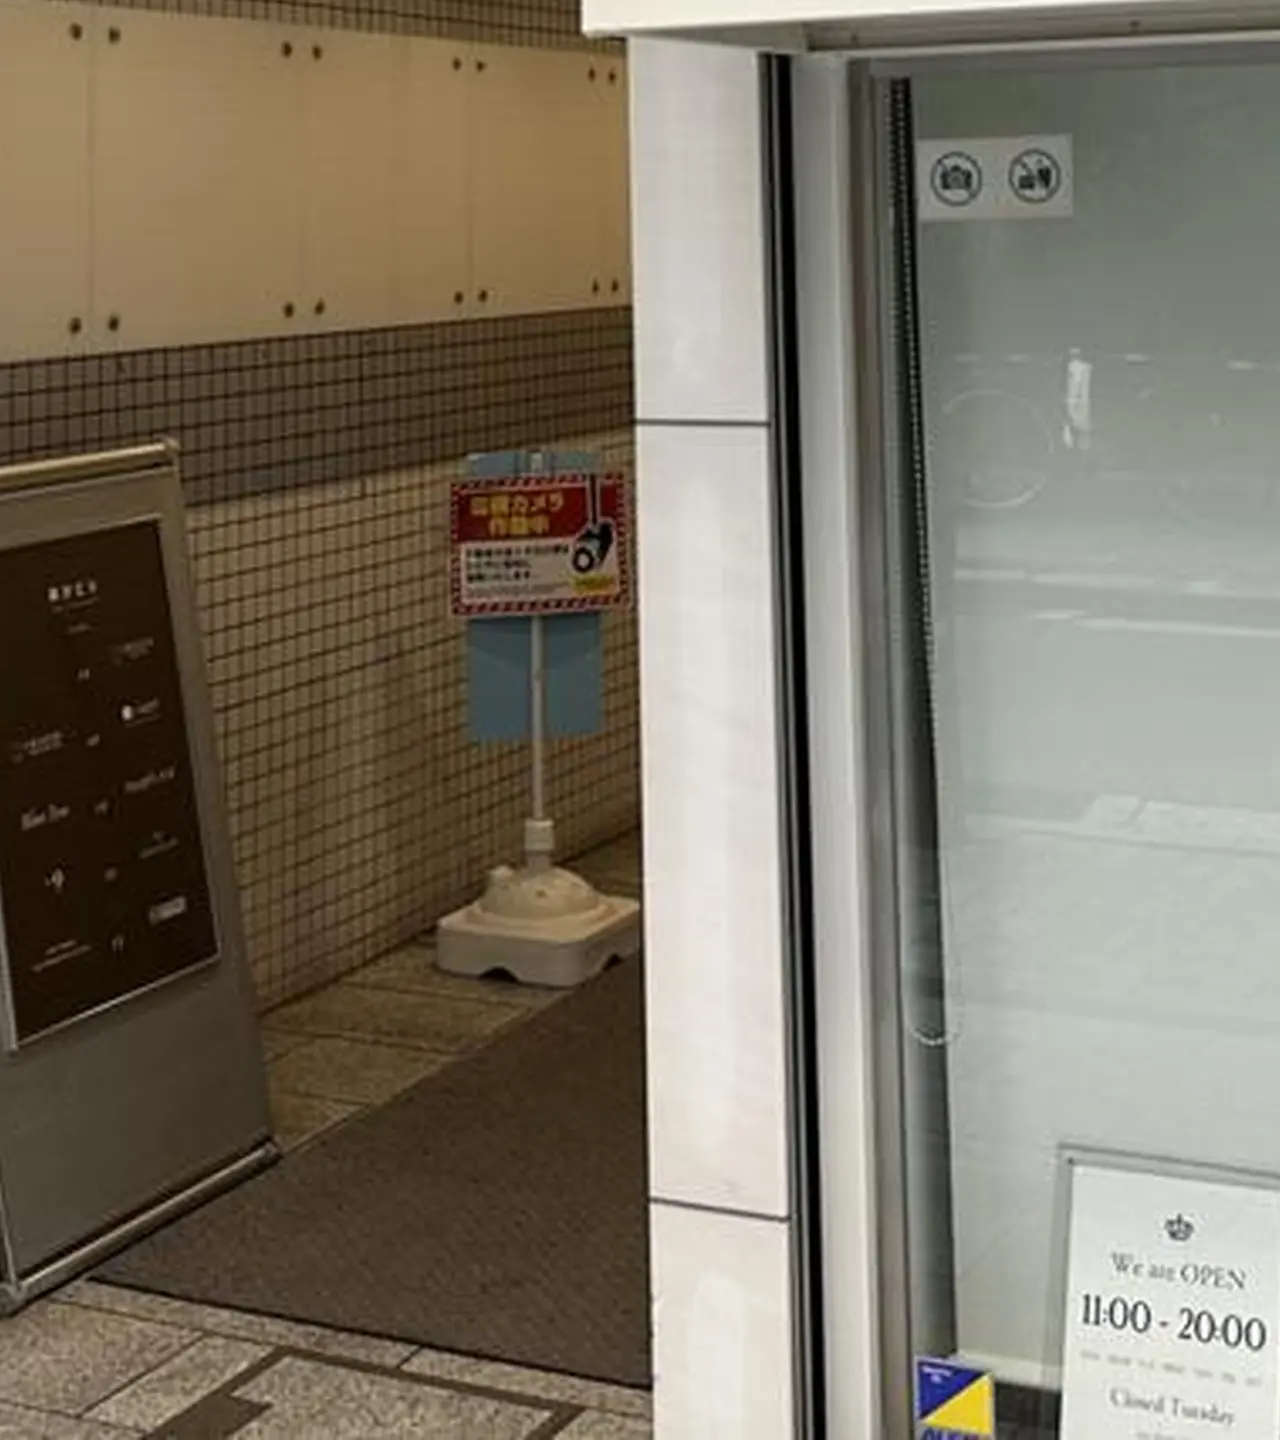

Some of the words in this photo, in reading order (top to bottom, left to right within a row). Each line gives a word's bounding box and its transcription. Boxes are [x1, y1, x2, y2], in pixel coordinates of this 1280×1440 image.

[1110, 1252, 1144, 1277] We
[1149, 1264, 1176, 1282] are
[1179, 1262, 1248, 1290] OPEN
[1081, 1292, 1153, 1335] 11:00
[1176, 1306, 1268, 1353] 20:00
